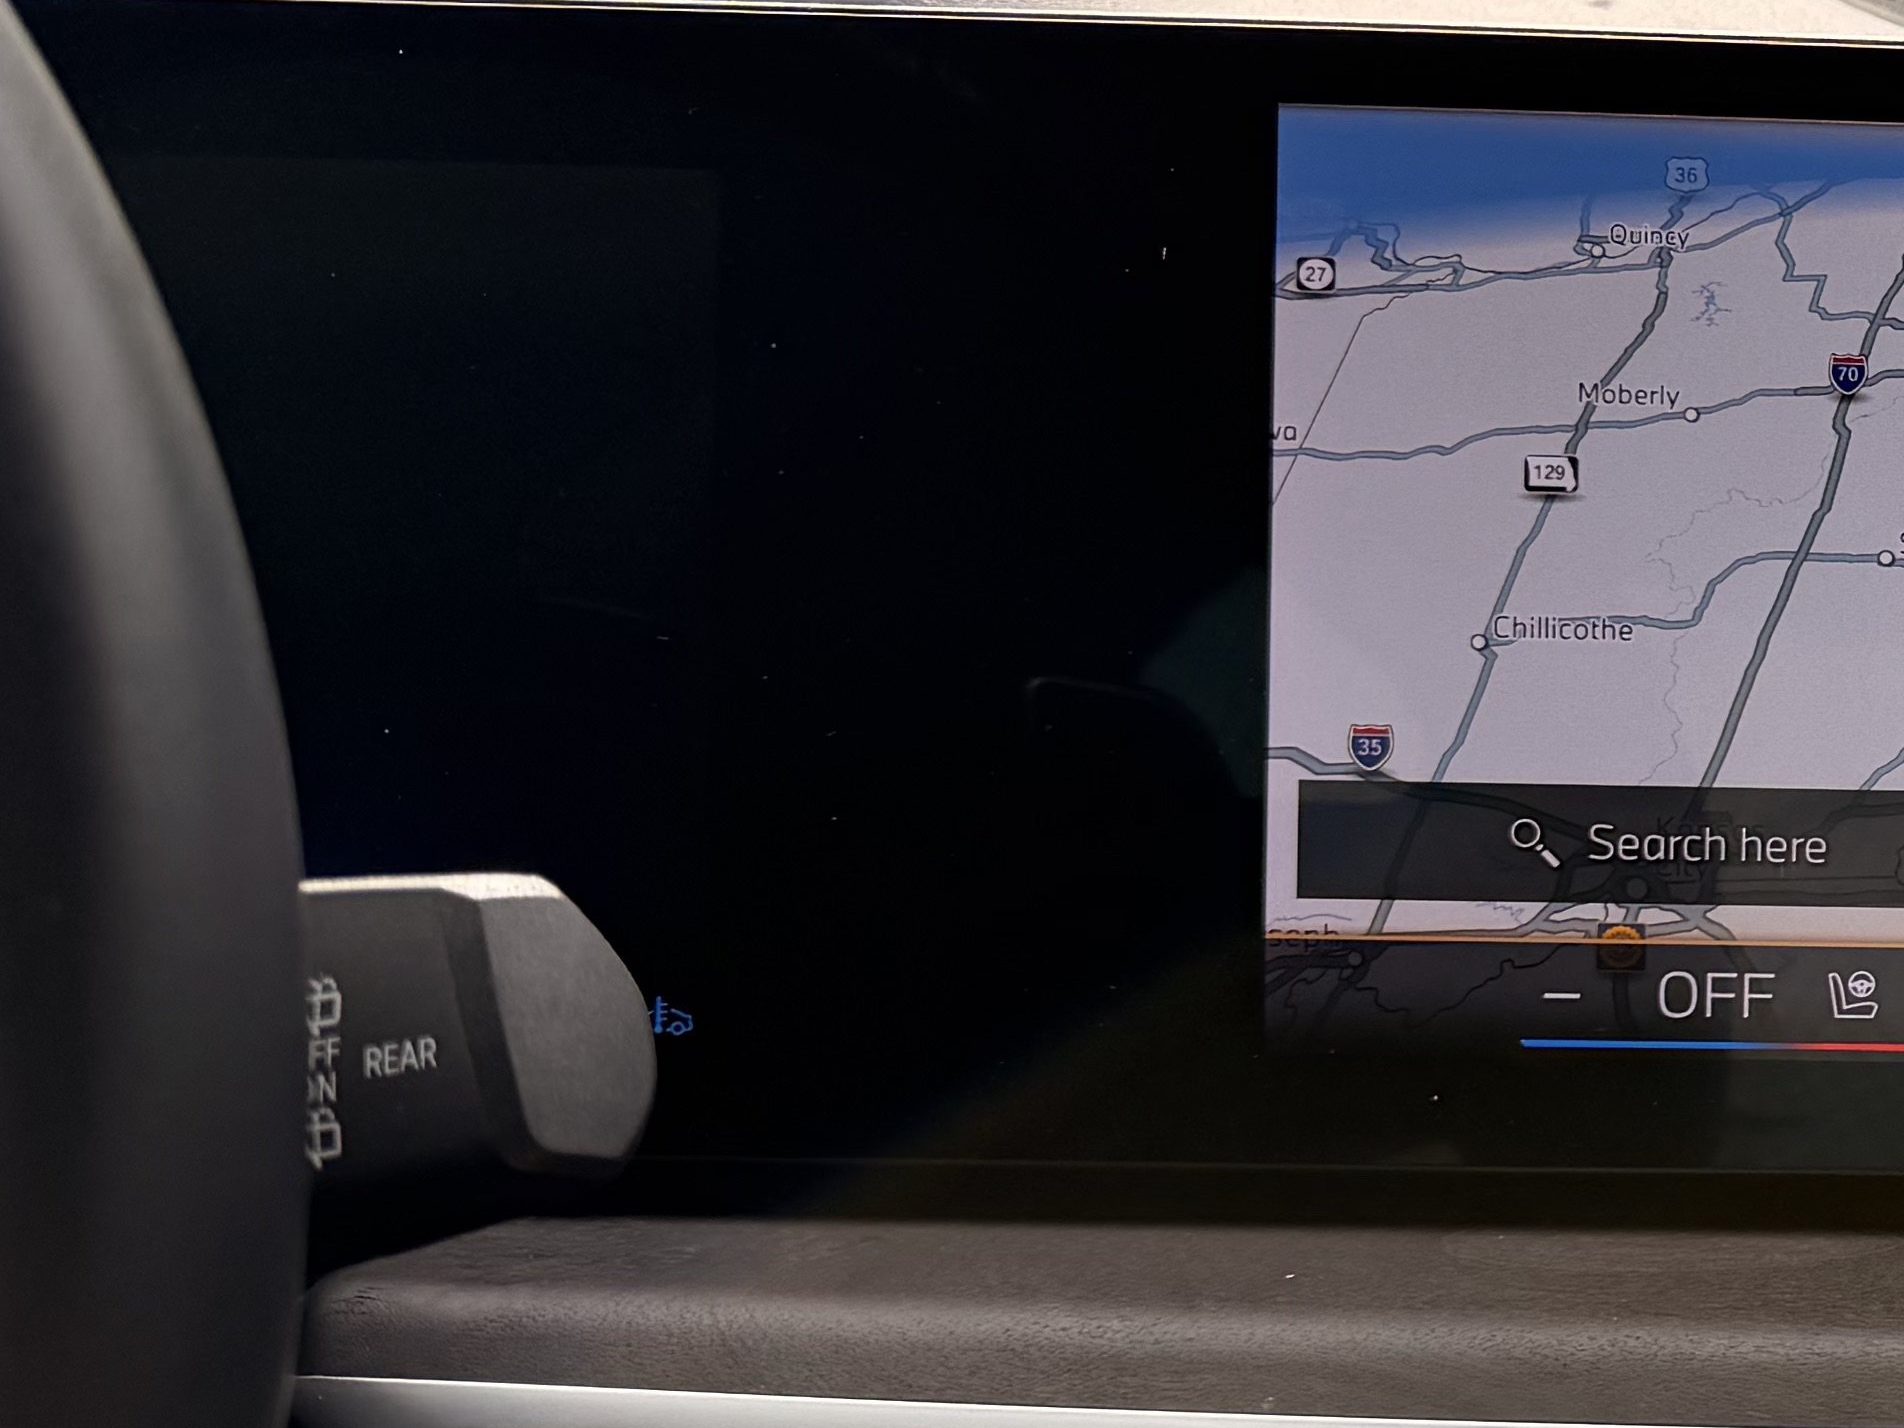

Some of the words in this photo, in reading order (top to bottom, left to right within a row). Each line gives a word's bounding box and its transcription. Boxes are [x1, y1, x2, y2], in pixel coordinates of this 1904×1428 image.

[1675, 166, 1698, 184] 36
[1610, 224, 1689, 250] Quincy
[1306, 266, 1326, 283] 27
[1838, 366, 1858, 383] 70
[1579, 383, 1679, 410] Moberly
[1534, 464, 1566, 481] 129
[1494, 616, 1633, 642] Chillicothe
[1358, 740, 1382, 755] 35
[1588, 824, 1725, 862] Search
[1741, 828, 1827, 864] here
[1659, 972, 1775, 1019] OFF
[363, 1035, 437, 1079] REAR
